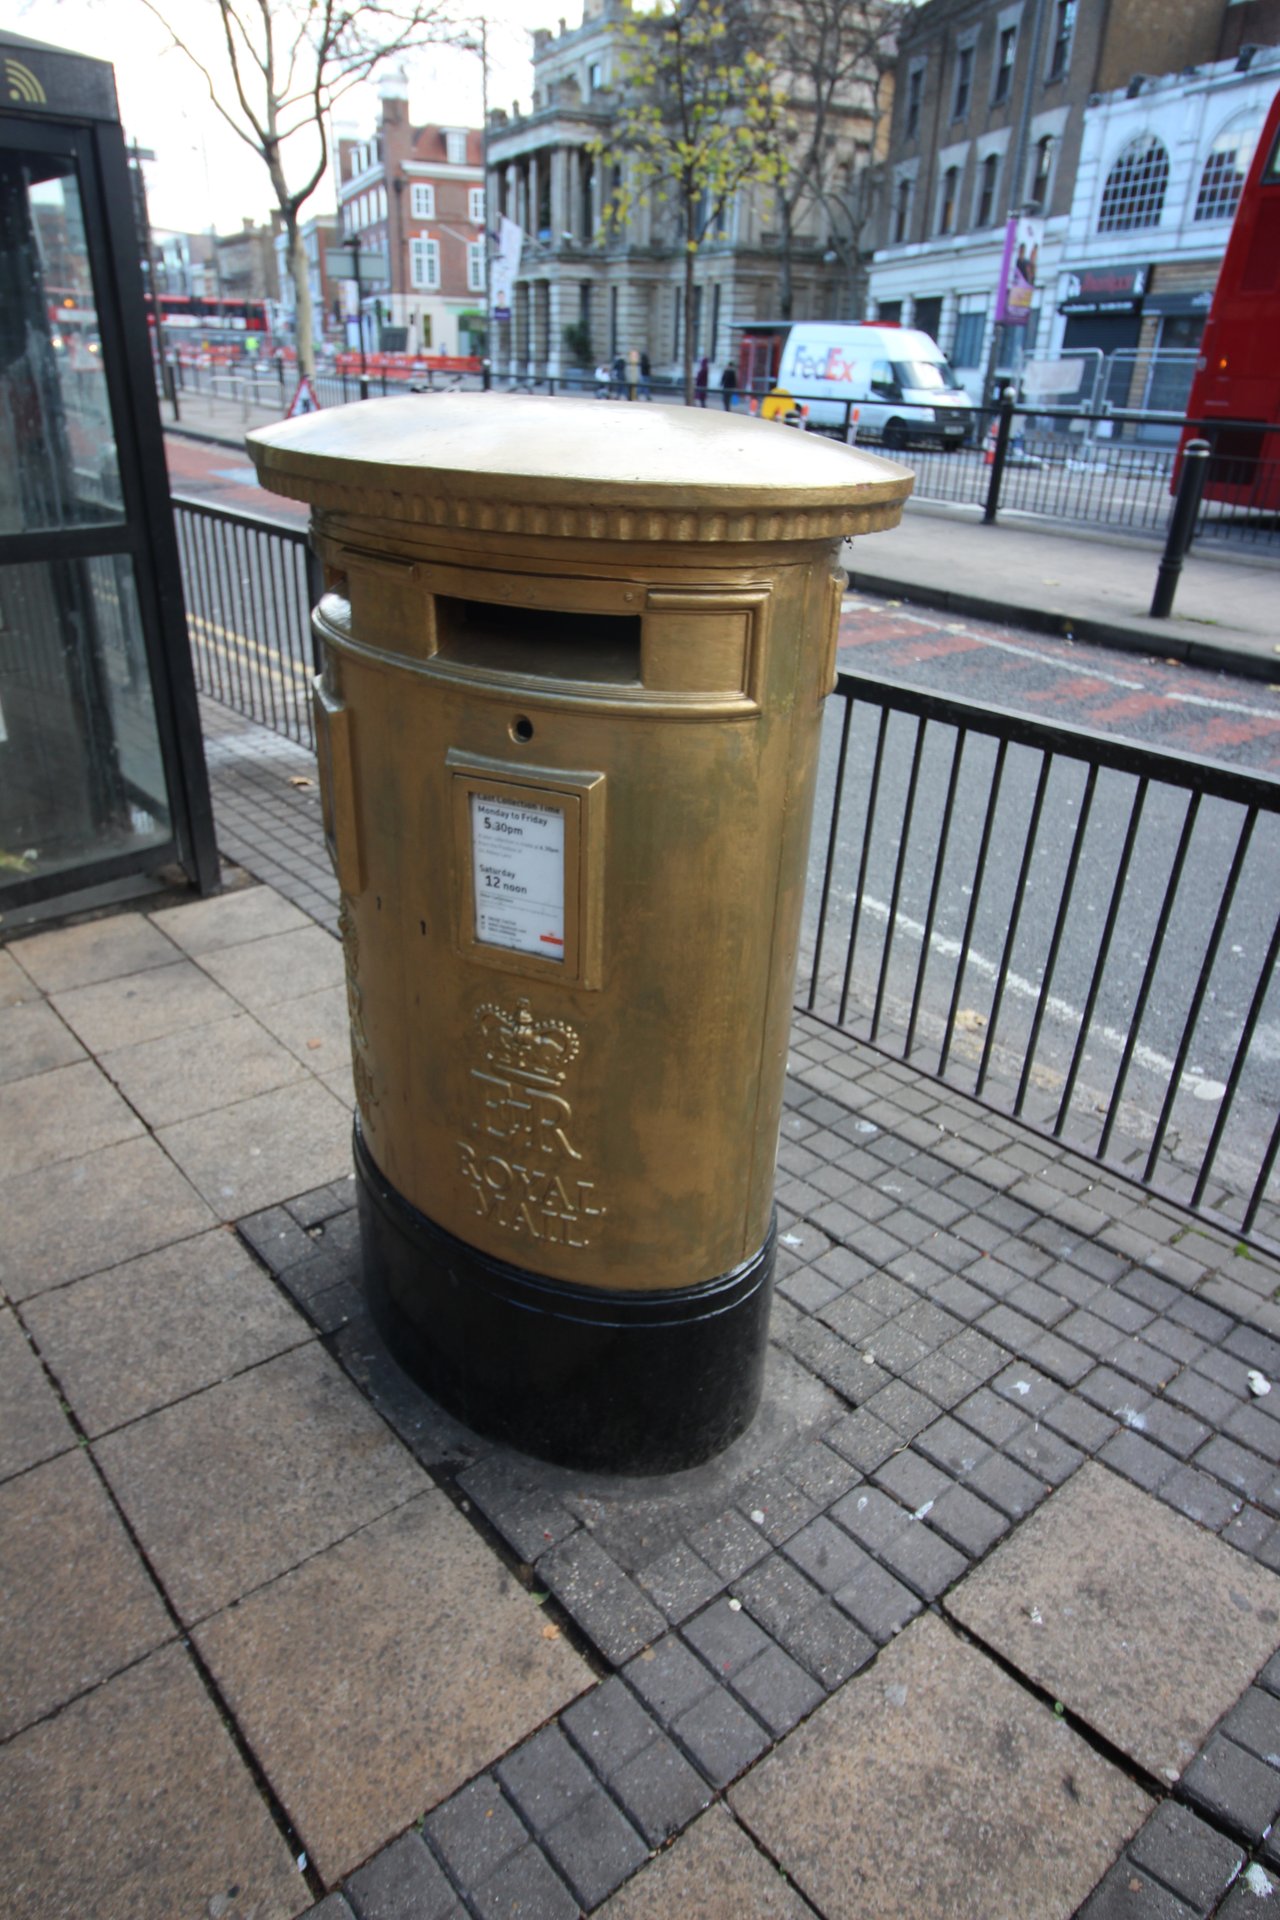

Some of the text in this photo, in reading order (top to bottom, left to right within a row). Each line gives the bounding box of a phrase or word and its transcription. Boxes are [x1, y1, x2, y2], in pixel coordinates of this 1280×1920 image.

[791, 346, 856, 383] FedEx
[478, 805, 548, 827] Monday to Friday
[484, 816, 524, 836] 5.30pm
[479, 864, 516, 880] Saturday
[485, 875, 527, 895] 12 noon
[456, 1140, 608, 1216] ROYAL
[470, 1182, 591, 1248] MAIL
